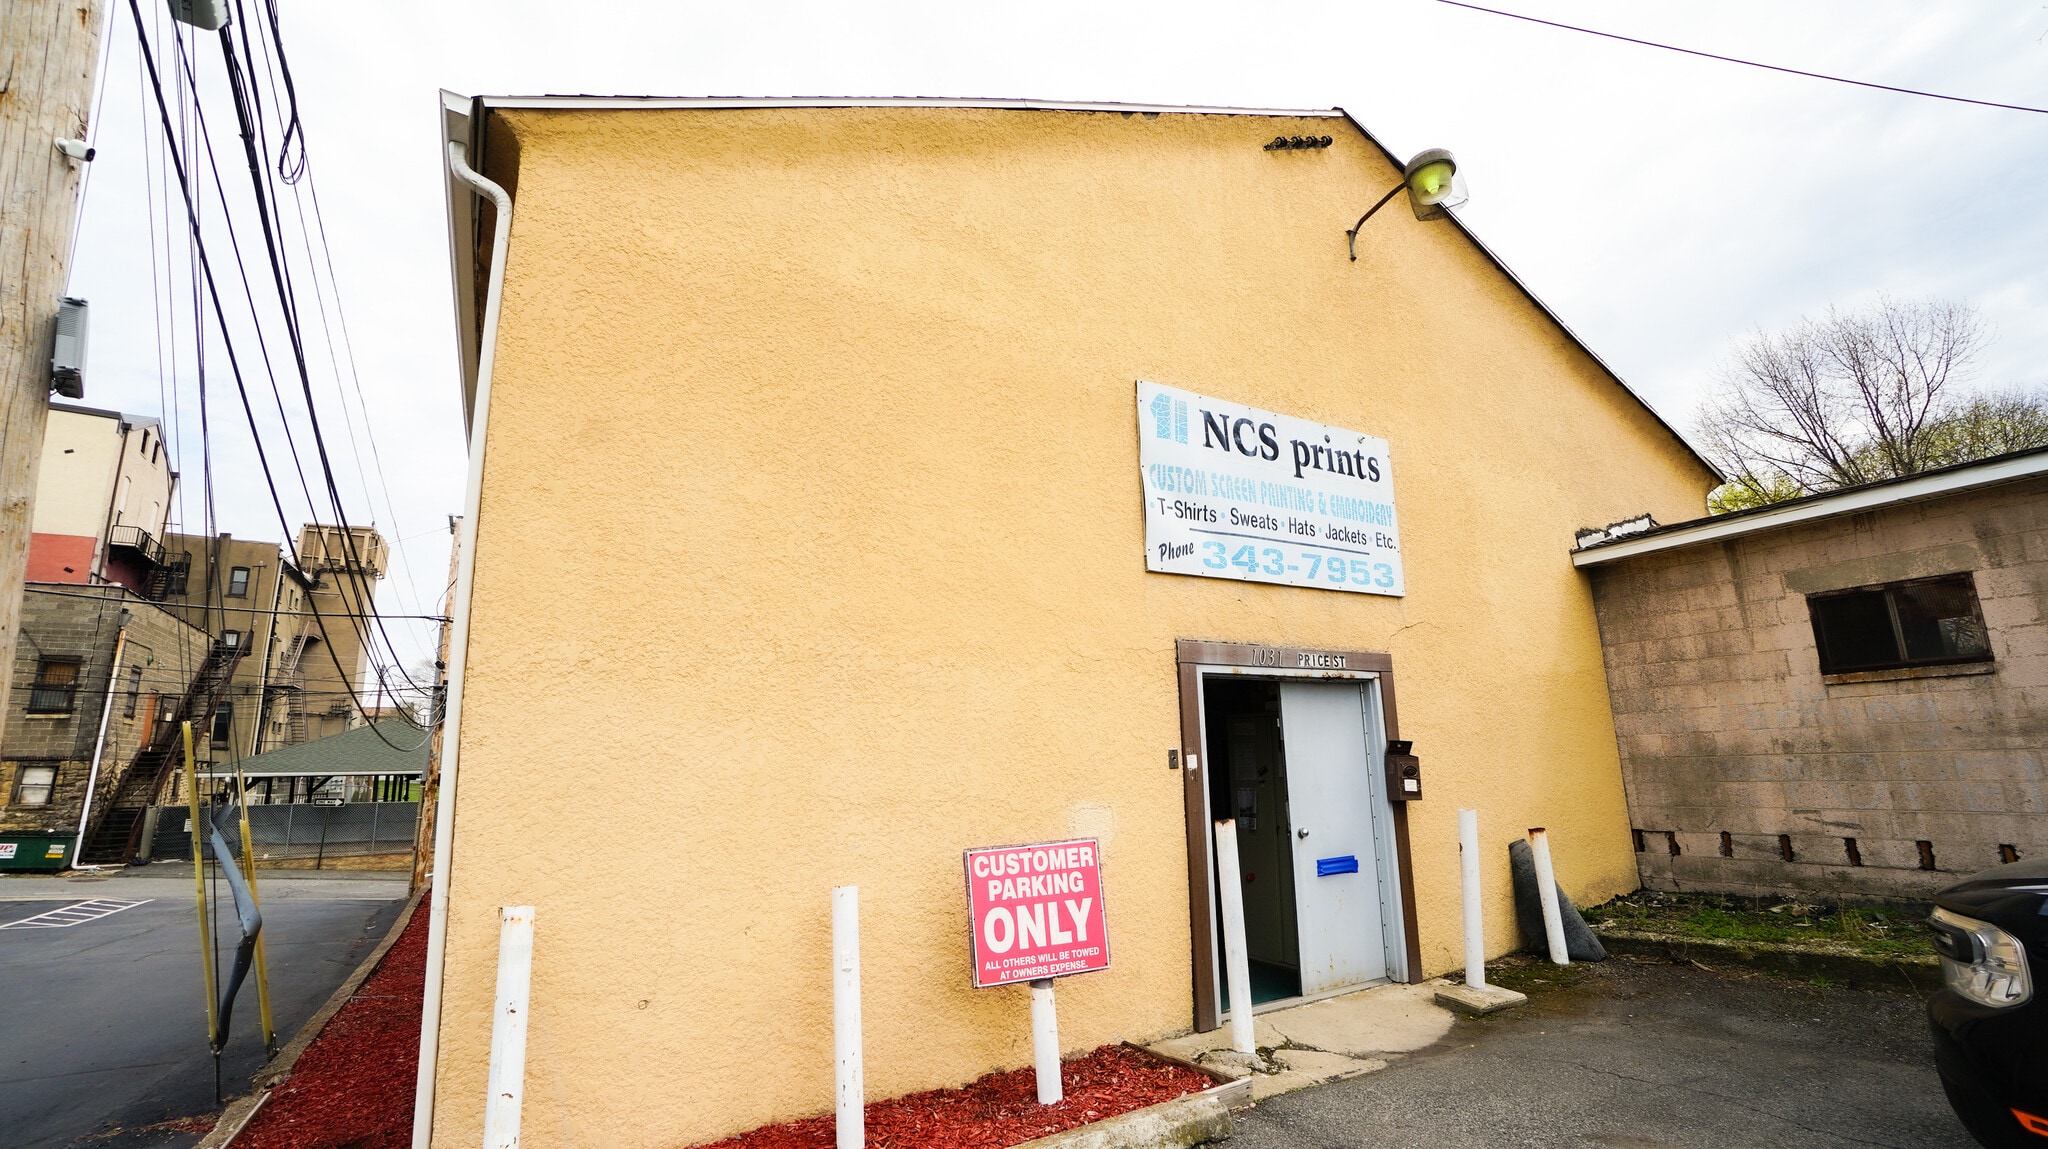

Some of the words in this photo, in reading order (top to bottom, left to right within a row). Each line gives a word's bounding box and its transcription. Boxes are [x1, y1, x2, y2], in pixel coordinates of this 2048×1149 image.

[1199, 409, 1280, 462] NCS
[1290, 434, 1381, 483] prints
[1149, 463, 1208, 496] CUSTOM
[1211, 472, 1257, 504] SCREEN
[1260, 480, 1315, 514] PRINTING
[1318, 491, 1327, 516] &
[1330, 494, 1393, 527] EMBROIDERY
[1157, 497, 1217, 523] T-Shirts
[1230, 507, 1278, 531] Sweats
[1288, 516, 1316, 537] Hats
[1325, 523, 1367, 545] Jackets
[1375, 532, 1397, 550] Etc.
[1158, 541, 1195, 562] Phone
[1202, 541, 1395, 588] 343-7953
[1251, 648, 1283, 666] 1031
[1297, 654, 1330, 668] PRICE
[1333, 656, 1345, 669] ST
[974, 847, 1094, 878] CUSTOMER
[988, 871, 1085, 901] PARKING
[984, 897, 1093, 954] ONLY
[985, 960, 1001, 971] ALL
[1003, 955, 1036, 968] OTHERS
[1038, 953, 1058, 963] WILL
[1059, 951, 1070, 960] BE
[1071, 947, 1100, 958] TOWED
[1000, 970, 1010, 981] AT
[1012, 965, 1049, 979] OWNERS
[1050, 960, 1089, 973] EXPENSE.
